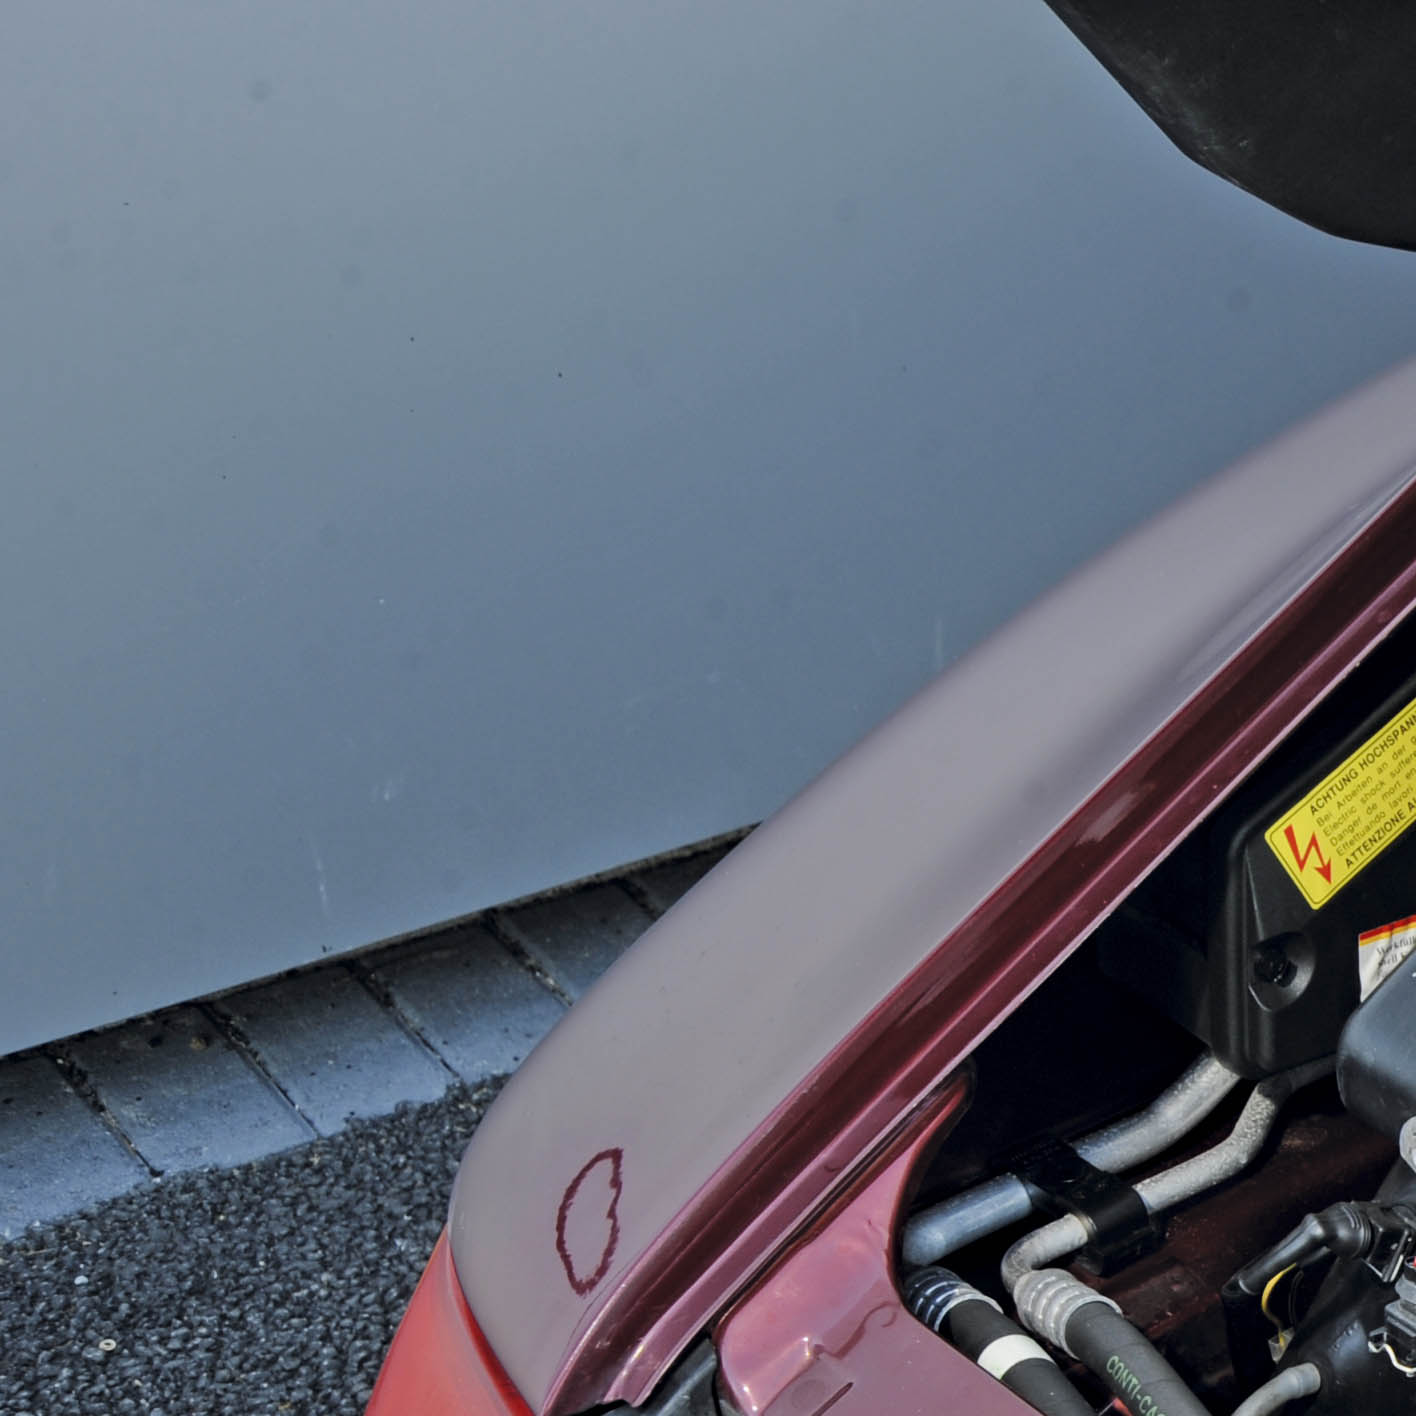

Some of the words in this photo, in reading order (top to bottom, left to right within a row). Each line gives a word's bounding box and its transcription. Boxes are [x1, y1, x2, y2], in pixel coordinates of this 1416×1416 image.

[1306, 766, 1359, 817] ACHTUNG
[1333, 772, 1374, 811] Arbeiten
[1389, 742, 1407, 761] der
[1343, 807, 1407, 870] ATTENZIONE
